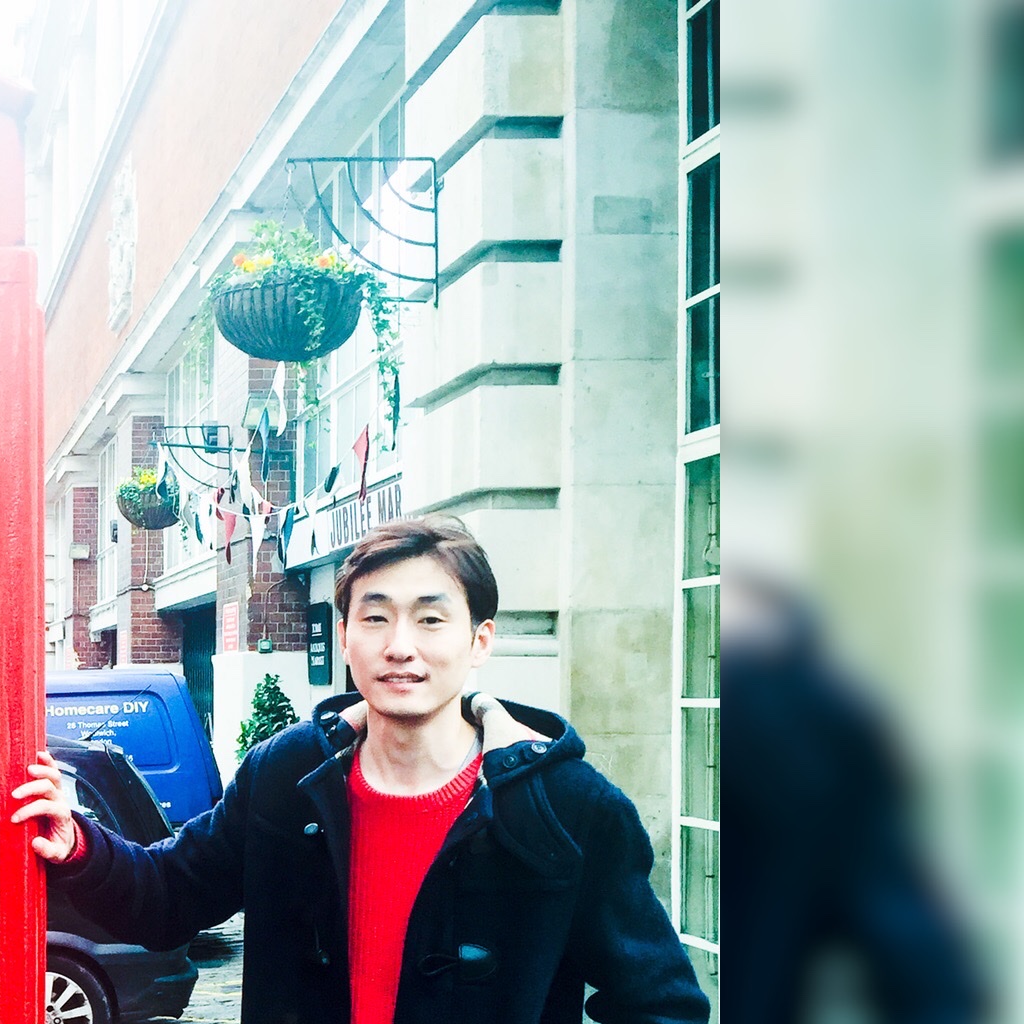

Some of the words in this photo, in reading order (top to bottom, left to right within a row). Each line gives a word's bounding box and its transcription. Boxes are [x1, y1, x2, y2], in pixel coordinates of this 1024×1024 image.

[330, 495, 372, 549] JUBILEE
[46, 704, 119, 717] Homecare
[123, 701, 149, 713] DIY
